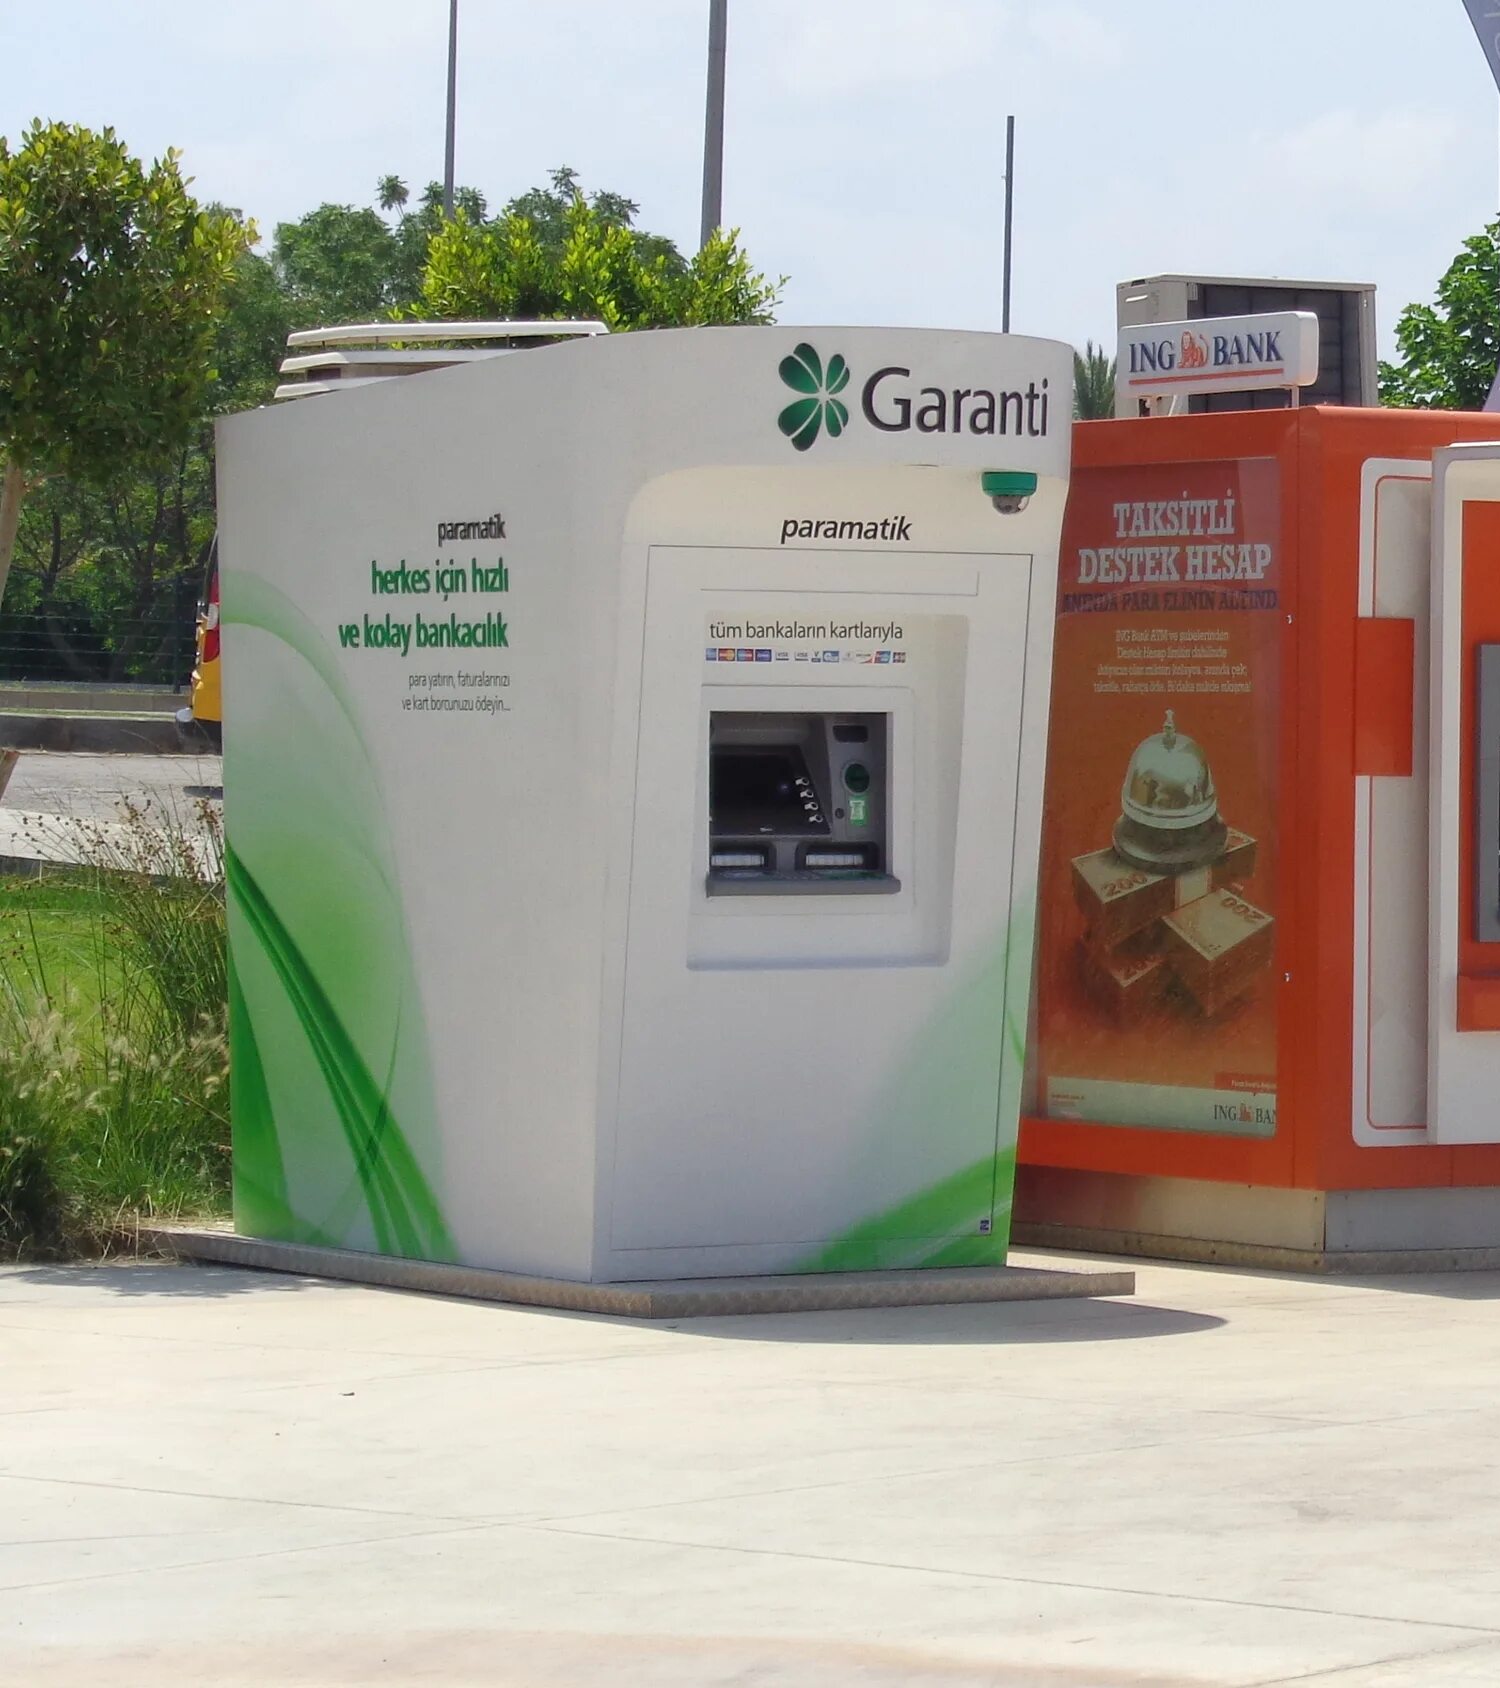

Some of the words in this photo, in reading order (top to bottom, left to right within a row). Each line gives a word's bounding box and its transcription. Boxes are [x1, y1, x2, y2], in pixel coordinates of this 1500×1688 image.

[1128, 340, 1177, 373] ING
[1213, 330, 1284, 366] BANK
[861, 366, 1049, 437] Garanti
[438, 513, 507, 547] paramatik
[780, 515, 913, 544] paramatik
[1113, 488, 1236, 538] TAKSİTLİ
[371, 559, 430, 595] herkes
[435, 558, 467, 601] için
[471, 557, 509, 593] hızlı
[1077, 547, 1181, 584] DESTEK
[1185, 543, 1272, 581] HESAP
[338, 624, 361, 648] ve
[363, 613, 412, 657] kolay
[415, 612, 509, 648] bankacılık
[710, 622, 742, 639] tüm
[746, 621, 826, 639] bankaların
[830, 621, 903, 643] kartlarıyla
[408, 675, 427, 690] para
[401, 699, 412, 711] ve
[413, 695, 430, 711] kart
[1213, 1104, 1237, 1122] ING
